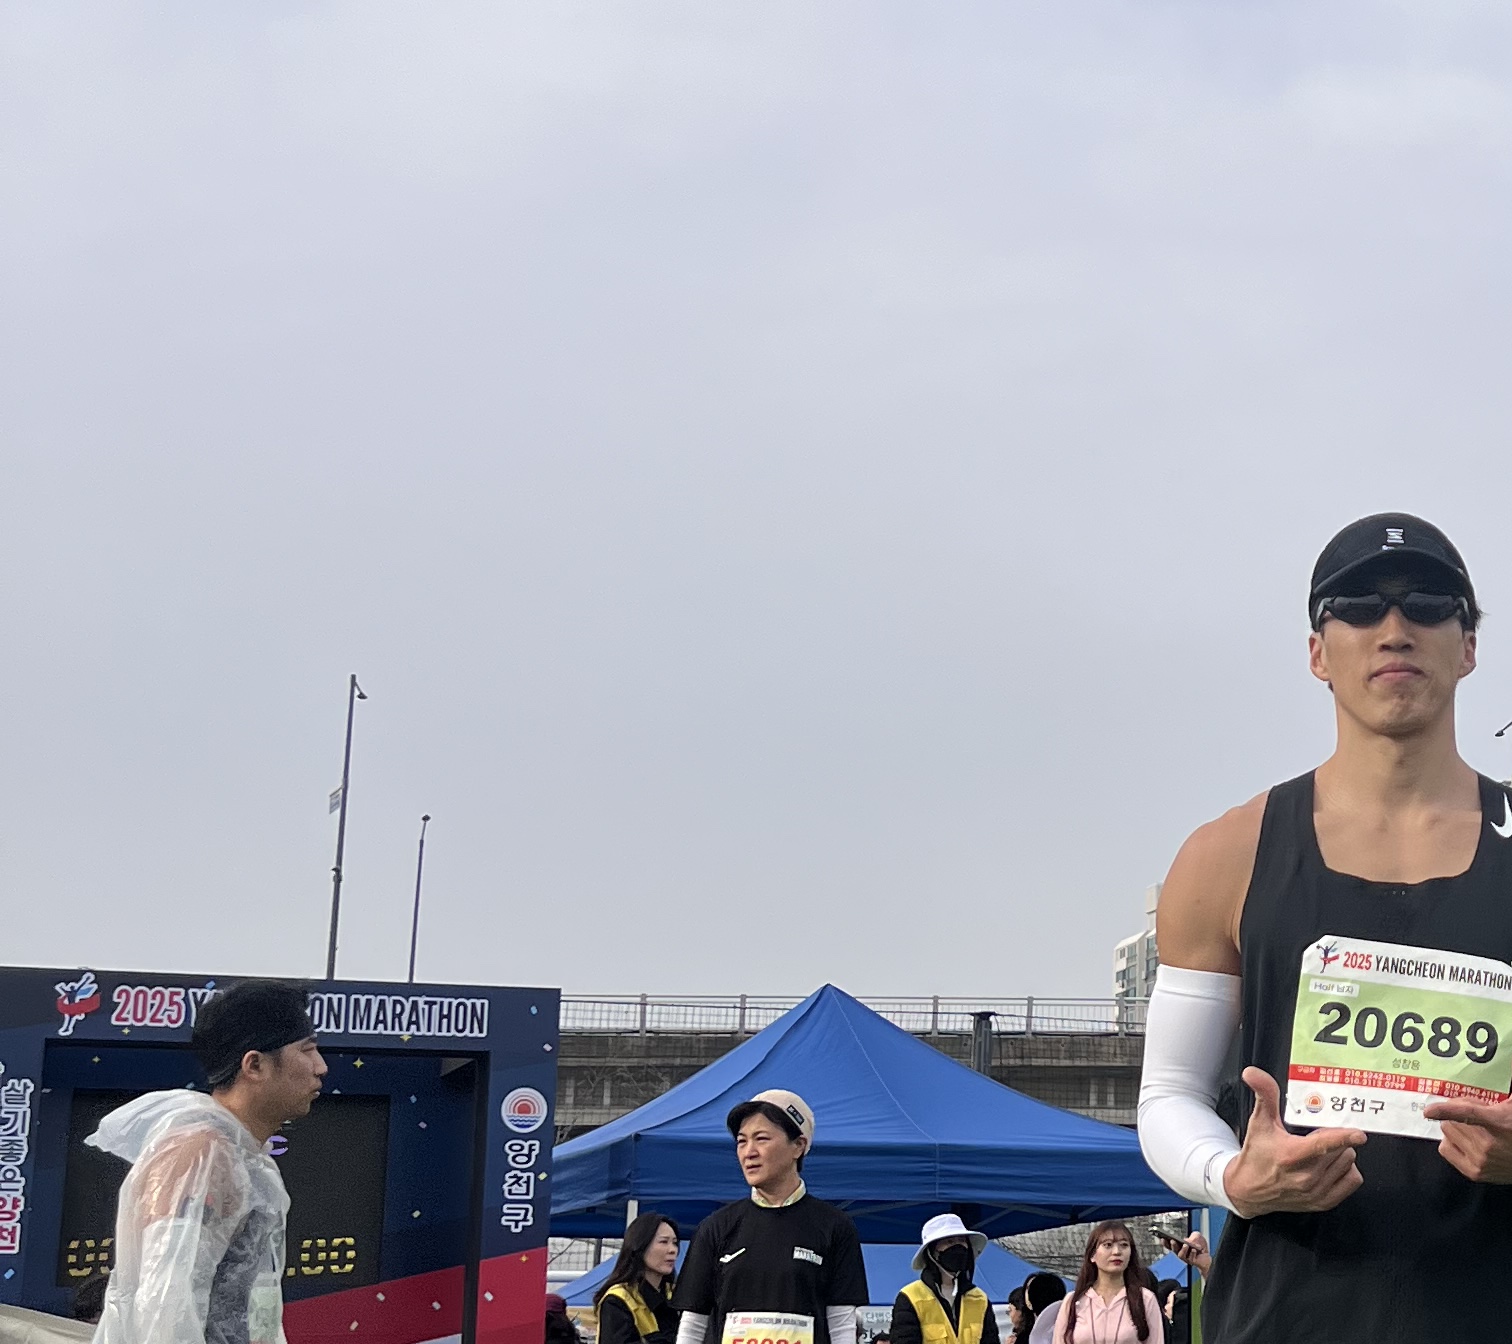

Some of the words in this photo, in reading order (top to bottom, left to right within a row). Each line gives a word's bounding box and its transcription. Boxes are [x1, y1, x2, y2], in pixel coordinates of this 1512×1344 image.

[1313, 982, 1336, 993] Half
[1343, 951, 1373, 971] 2025
[1375, 954, 1446, 981] YANGCHEON
[1449, 965, 1512, 991] MARATHON
[112, 986, 186, 1028] 2025
[351, 994, 489, 1037] MARATHON
[1313, 1001, 1499, 1063] 20689
[1330, 1096, 1386, 1115] 양천구
[503, 1140, 540, 1233] 양천구
